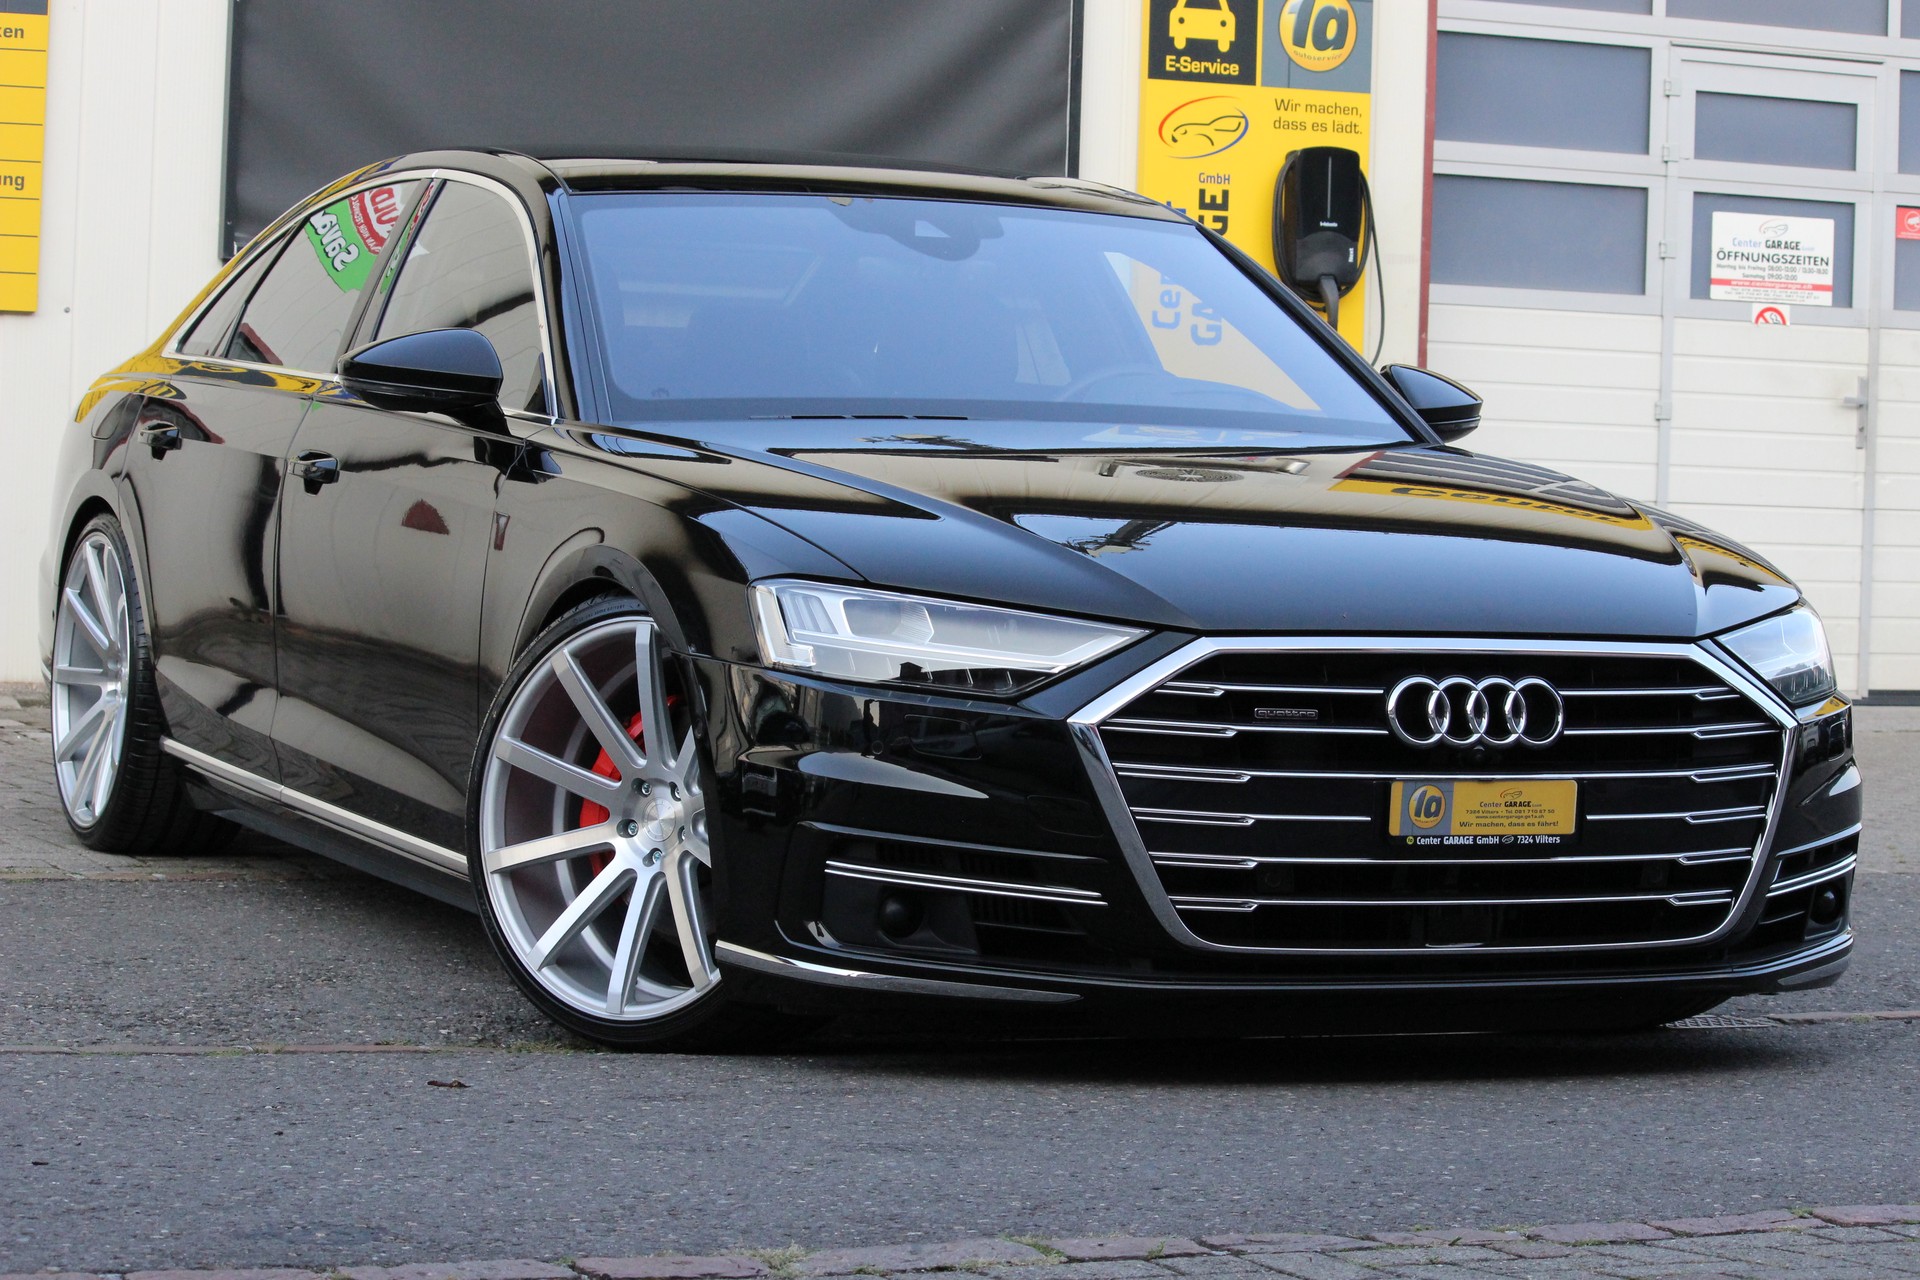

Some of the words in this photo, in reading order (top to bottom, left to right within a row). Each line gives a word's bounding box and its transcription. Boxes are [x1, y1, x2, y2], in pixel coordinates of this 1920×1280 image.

[1293, 50, 1343, 61] autoservice
[1165, 55, 1240, 76] E-Service
[1274, 98, 1301, 112] Wir
[1305, 102, 1362, 118] machen,
[1273, 116, 1307, 131] dass
[1311, 121, 1328, 132] es
[1332, 119, 1363, 134] lädt.
[1198, 172, 1231, 185] GmbH
[1732, 237, 1761, 248] Center
[1765, 240, 1801, 251] GARAGE
[1716, 248, 1830, 266] ÖFFNUNGSZEITEN
[1258, 710, 1316, 719] quattro
[1413, 790, 1443, 818] 1a
[1417, 836, 1441, 845] Center
[1443, 836, 1474, 845] GARAGE
[1476, 836, 1500, 844] GmbH
[1536, 835, 1561, 843] Vilters
